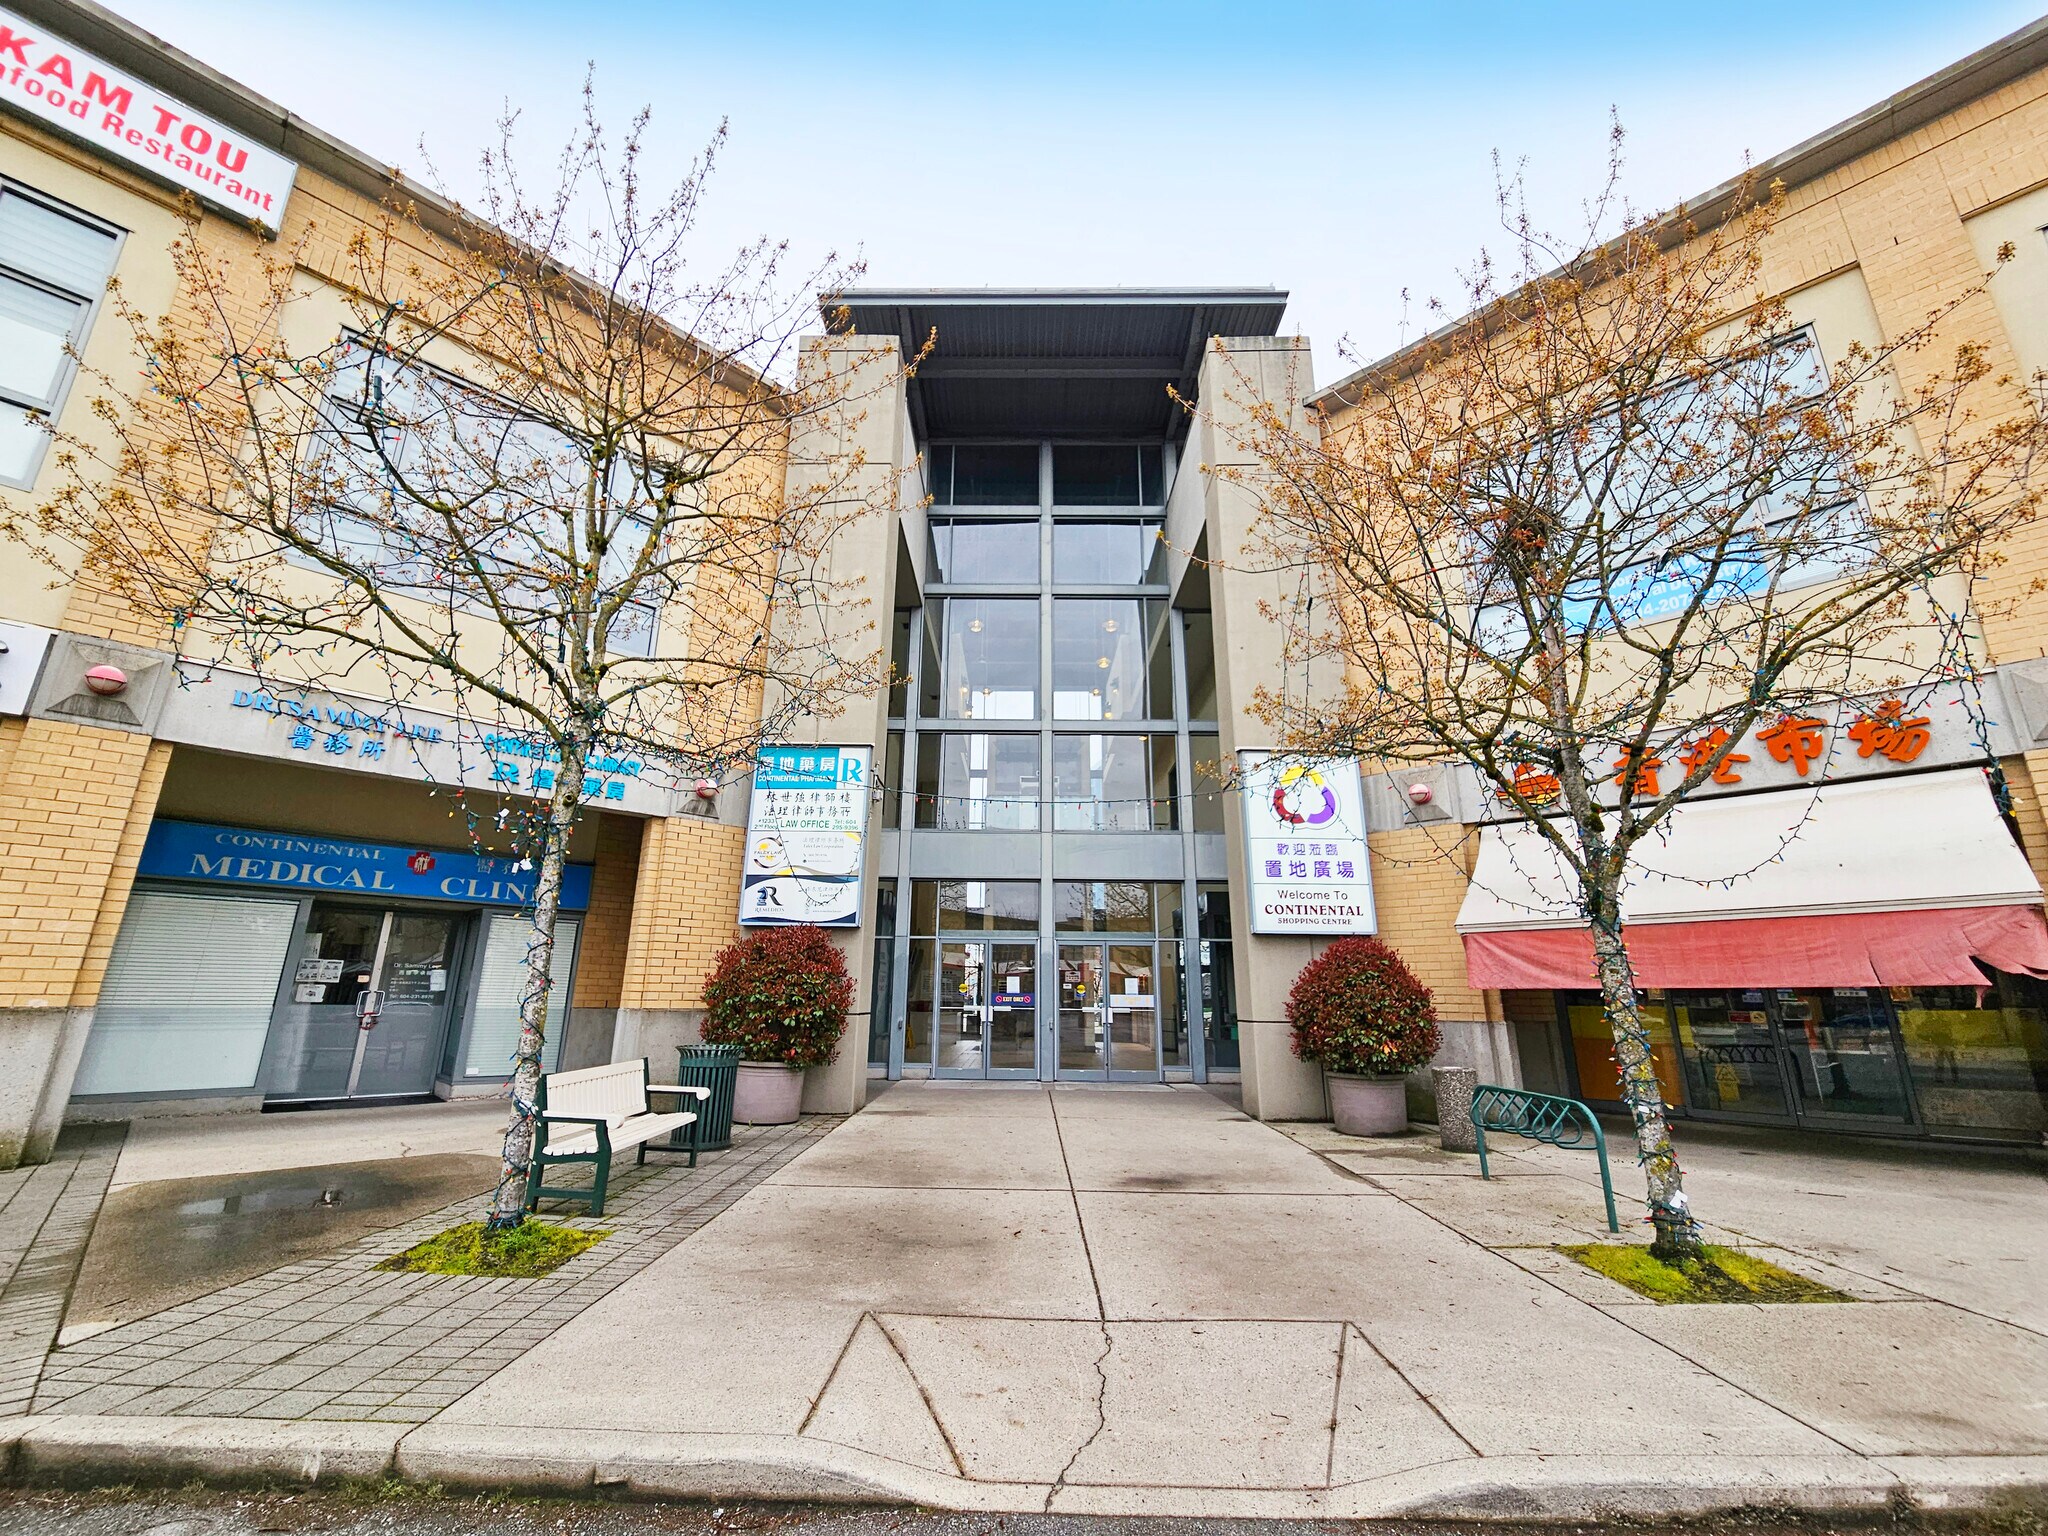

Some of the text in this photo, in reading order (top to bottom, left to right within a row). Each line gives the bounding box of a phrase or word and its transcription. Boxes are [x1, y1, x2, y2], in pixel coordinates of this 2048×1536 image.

[0, 24, 253, 174] KAM TOU
[101, 112, 274, 212] Restaurant
[231, 689, 280, 714] DR.
[287, 699, 388, 734] SAMMY
[287, 724, 387, 762] 醫務所
[780, 820, 830, 829] LAW OFFICE
[215, 831, 387, 861] CONTINENTAL
[187, 852, 396, 891] MEDICAL
[1264, 859, 1355, 878] 置地廣場
[1264, 904, 1364, 916] CONTINENTAL
[1277, 889, 1348, 900] Welcome To
